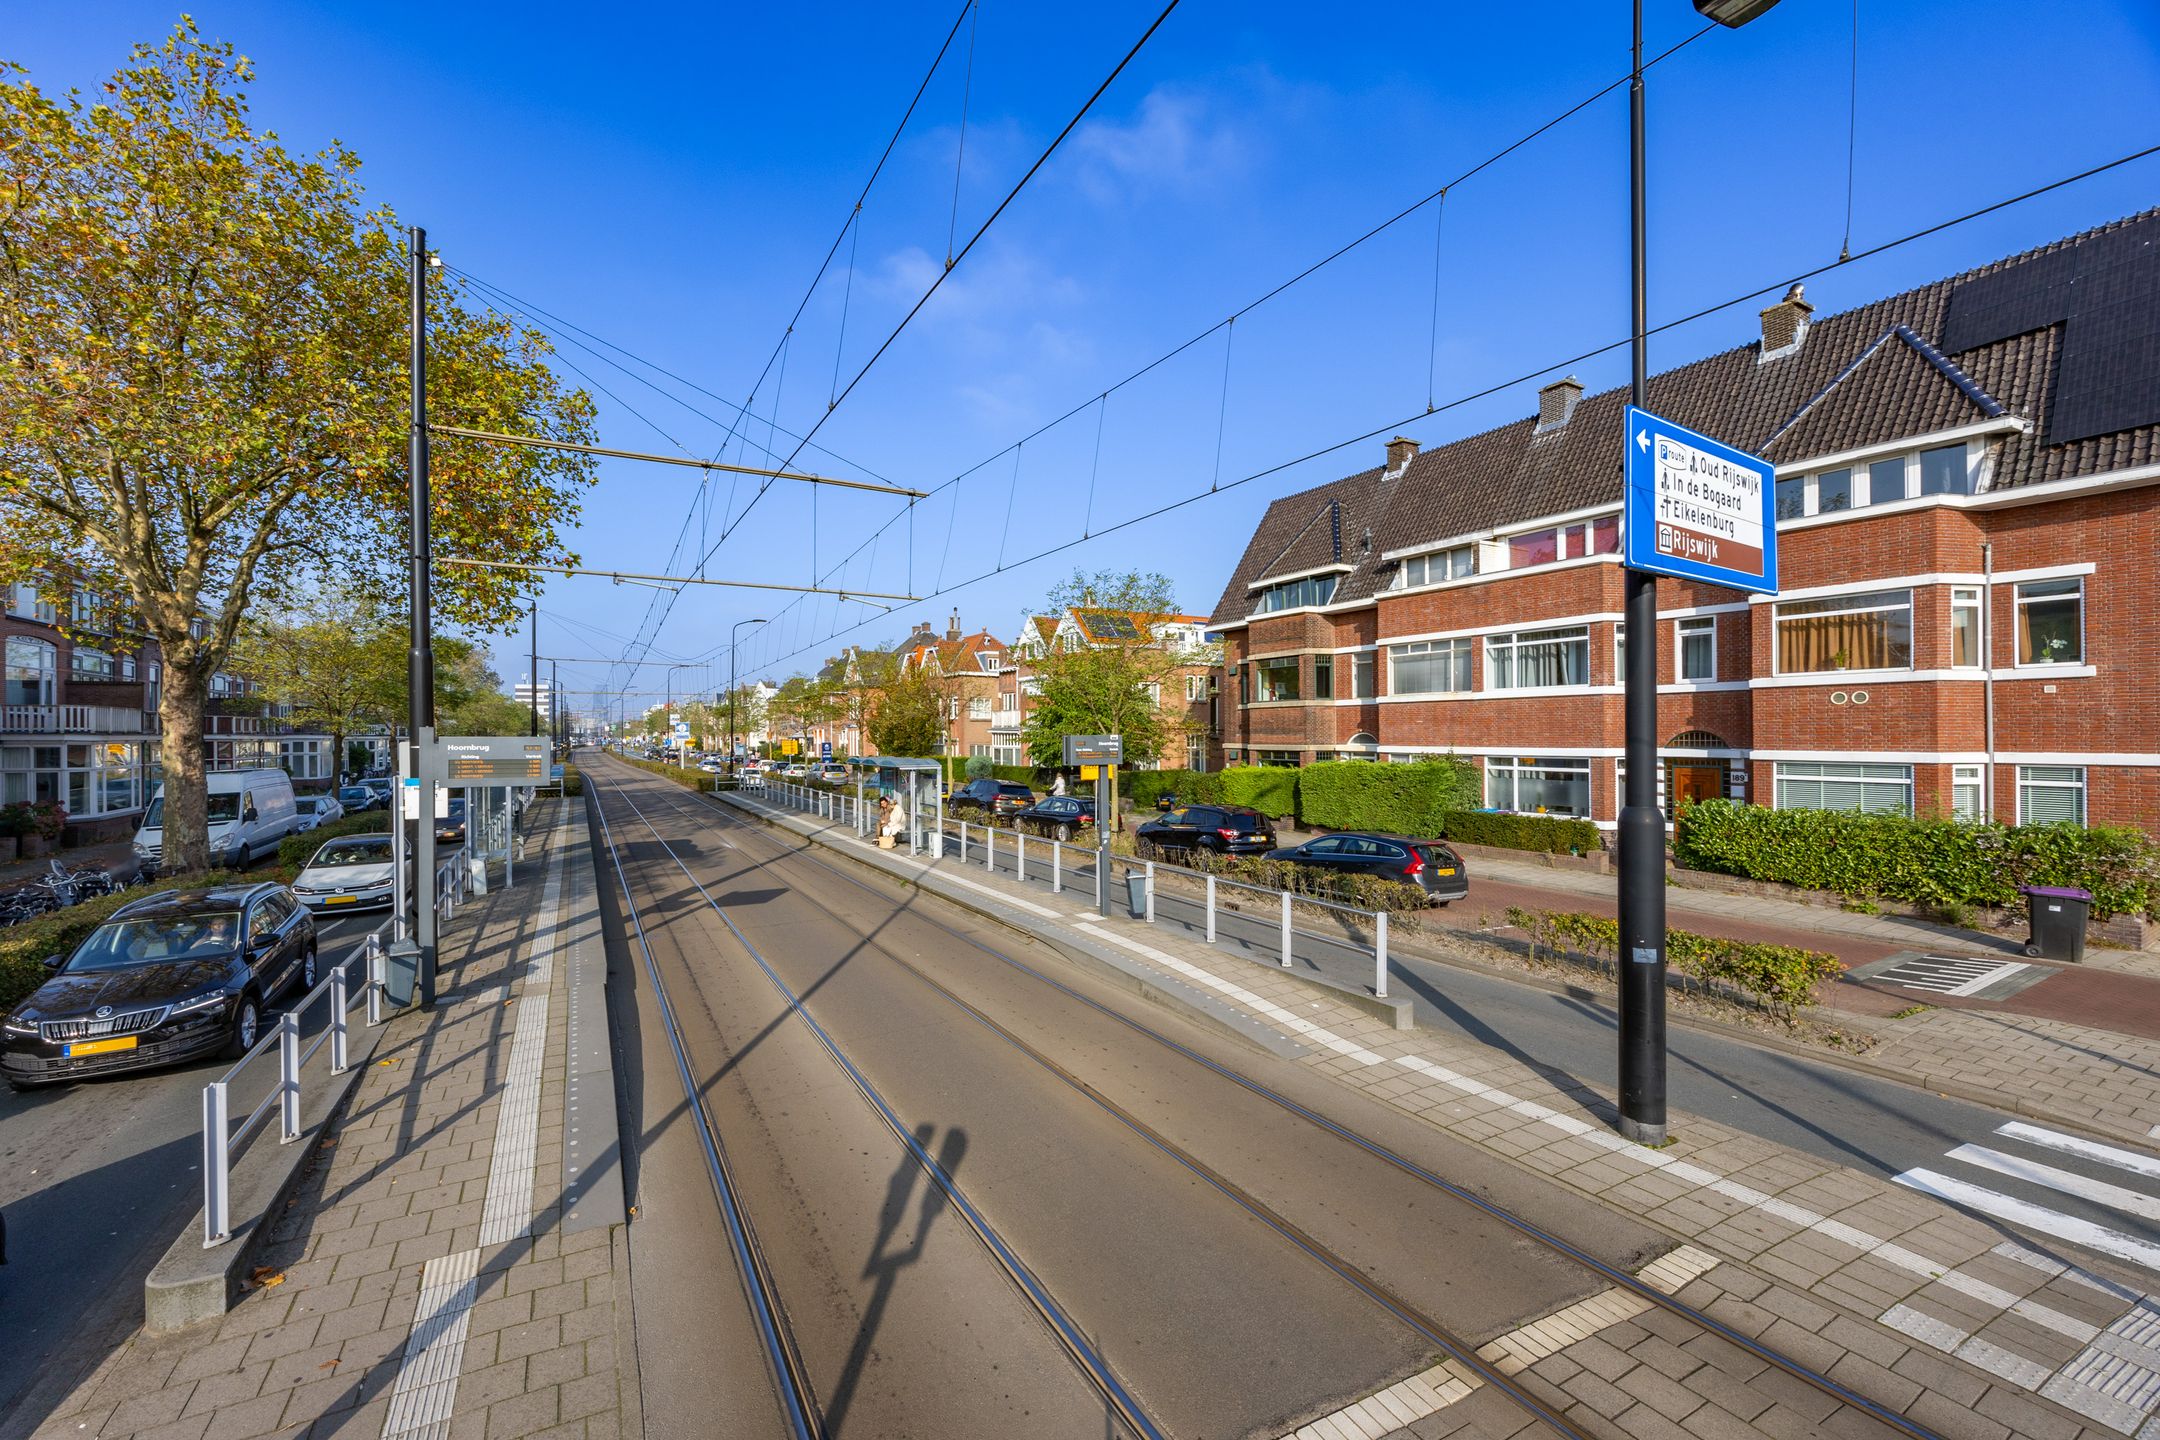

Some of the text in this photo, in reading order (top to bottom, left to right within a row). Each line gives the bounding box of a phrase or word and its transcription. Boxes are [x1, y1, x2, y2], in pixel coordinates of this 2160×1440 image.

[1668, 450, 1684, 463] route
[1673, 473, 1742, 511] In de Bogaard
[1700, 457, 1759, 496] Oud Rijswijk
[1673, 500, 1735, 537] Eikelenburg
[1673, 530, 1718, 562] Rijswijk
[447, 744, 490, 752] Hoornbrug
